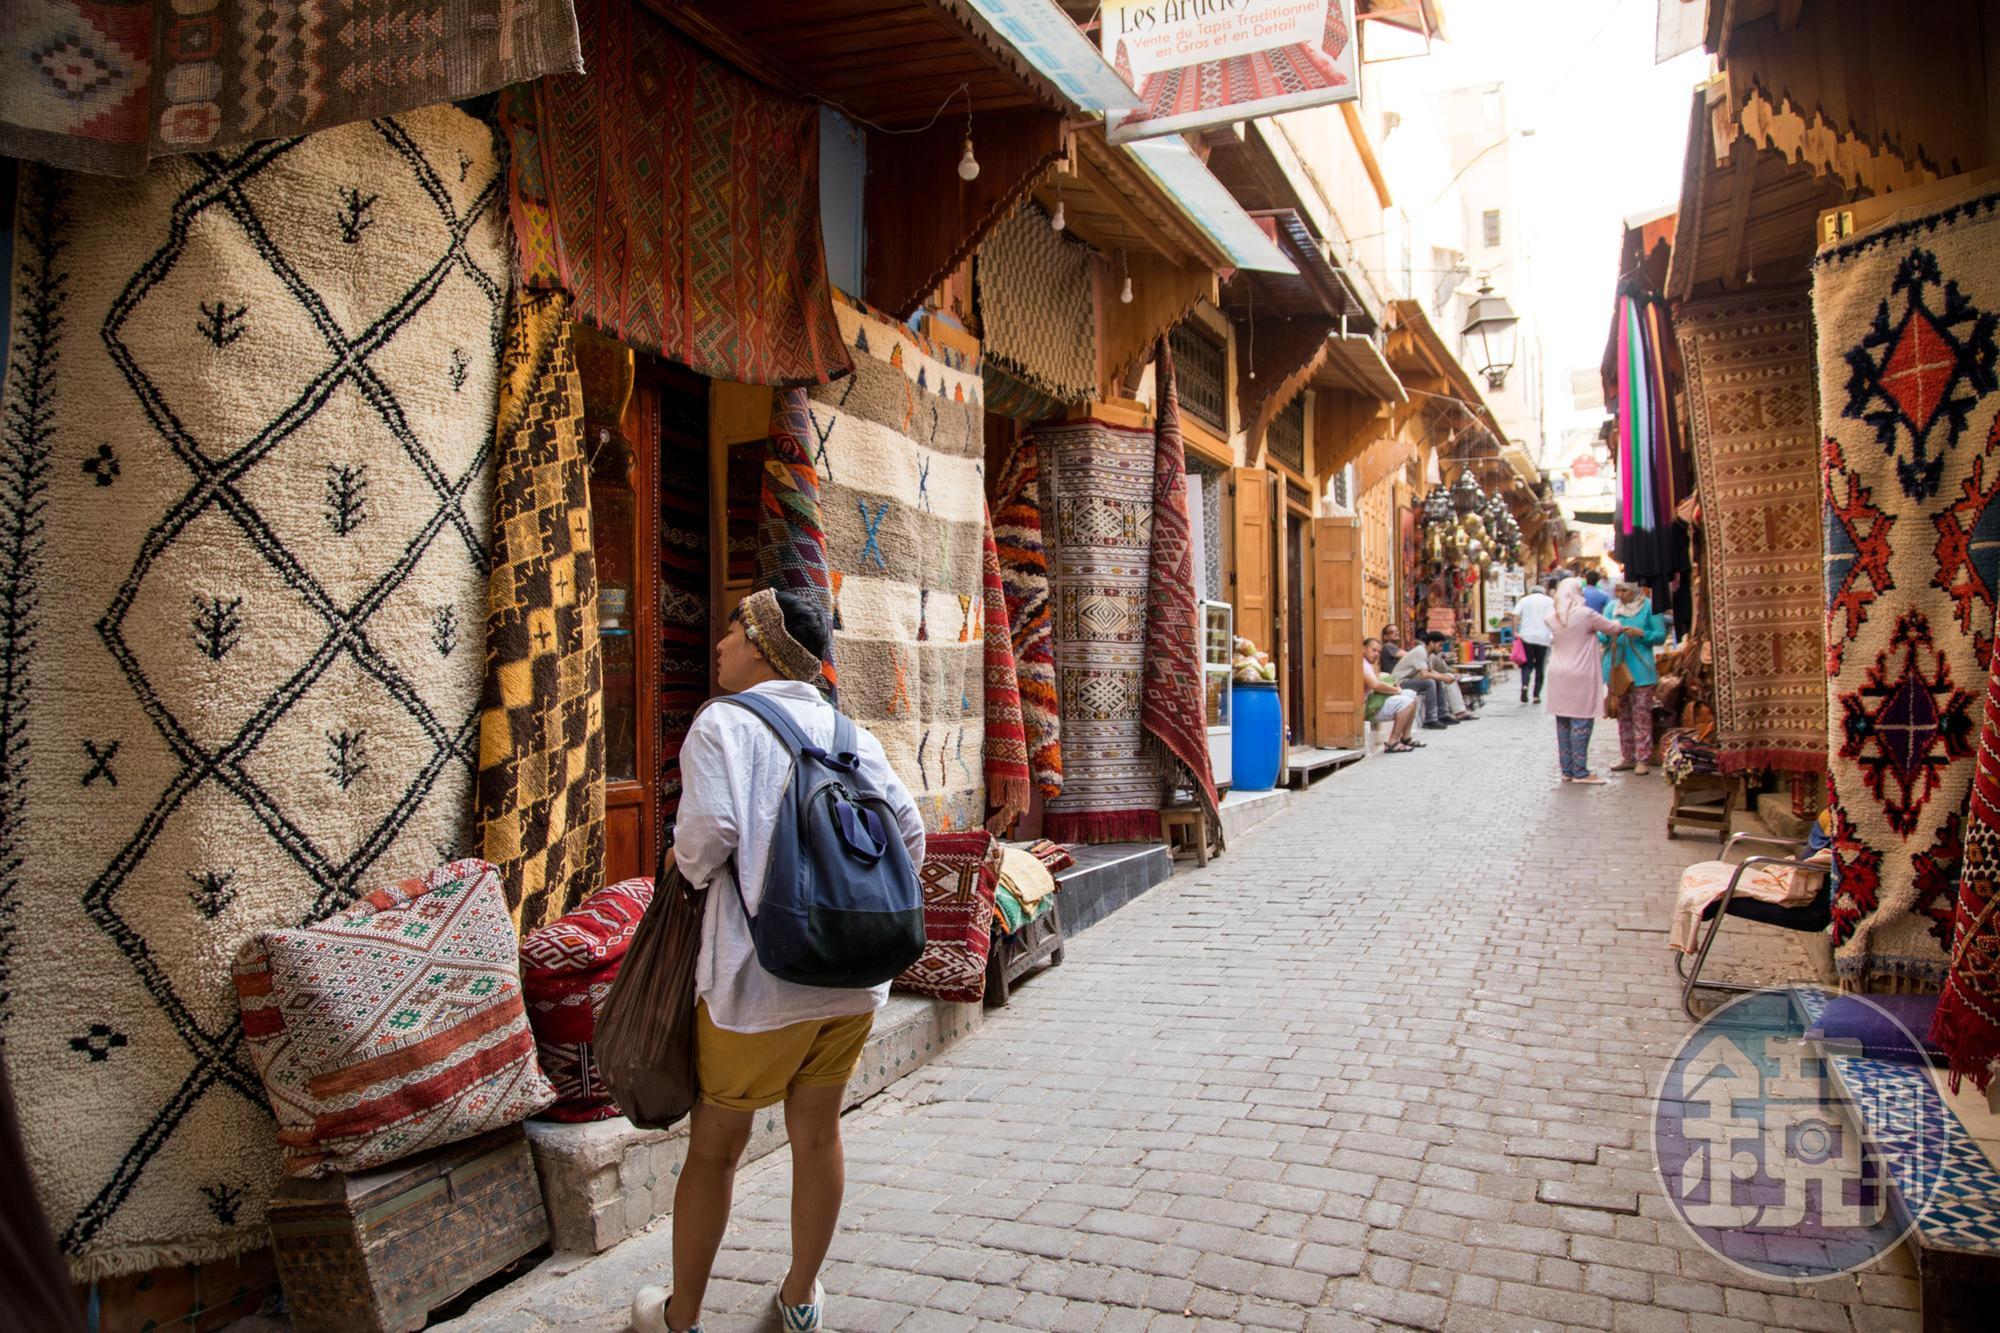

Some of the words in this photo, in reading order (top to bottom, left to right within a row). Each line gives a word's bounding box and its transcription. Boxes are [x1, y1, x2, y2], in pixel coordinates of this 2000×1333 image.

[1120, 6, 1156, 34] Les
[1133, 34, 1170, 48] Vente
[1176, 27, 1192, 40] du
[1197, 19, 1232, 36] Tapis
[1237, 1, 1320, 26] Traditionnel
[1156, 47, 1172, 58] en
[1176, 39, 1209, 53] Gros
[1213, 34, 1227, 45] et
[1232, 31, 1249, 42] en
[1253, 17, 1296, 37] Detail
